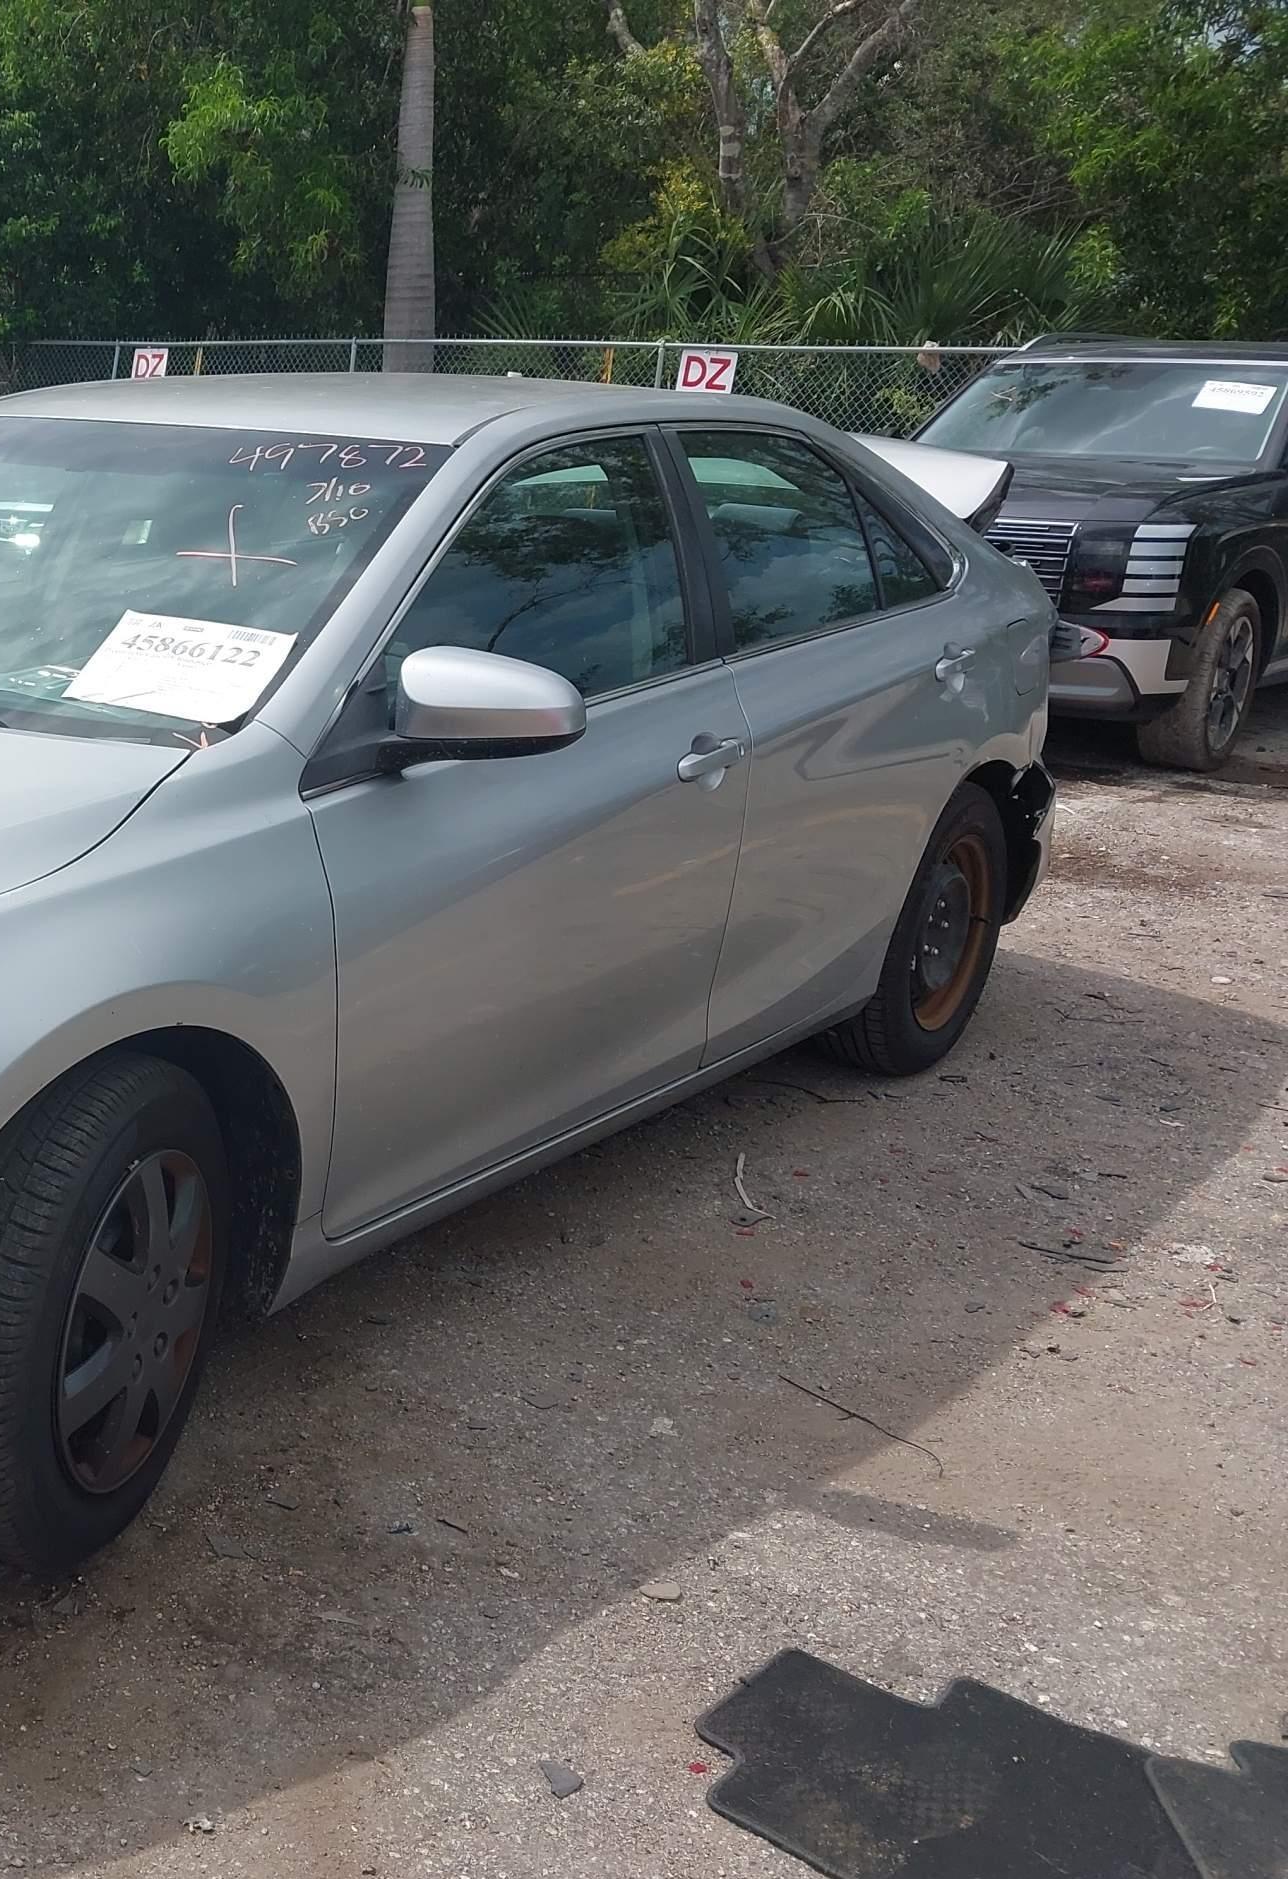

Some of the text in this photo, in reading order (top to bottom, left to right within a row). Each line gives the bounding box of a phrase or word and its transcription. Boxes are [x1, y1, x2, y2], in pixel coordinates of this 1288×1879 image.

[134, 352, 165, 379] DZ
[681, 355, 732, 391] DZ
[228, 442, 428, 472] 497872
[120, 632, 262, 668] 45866122
